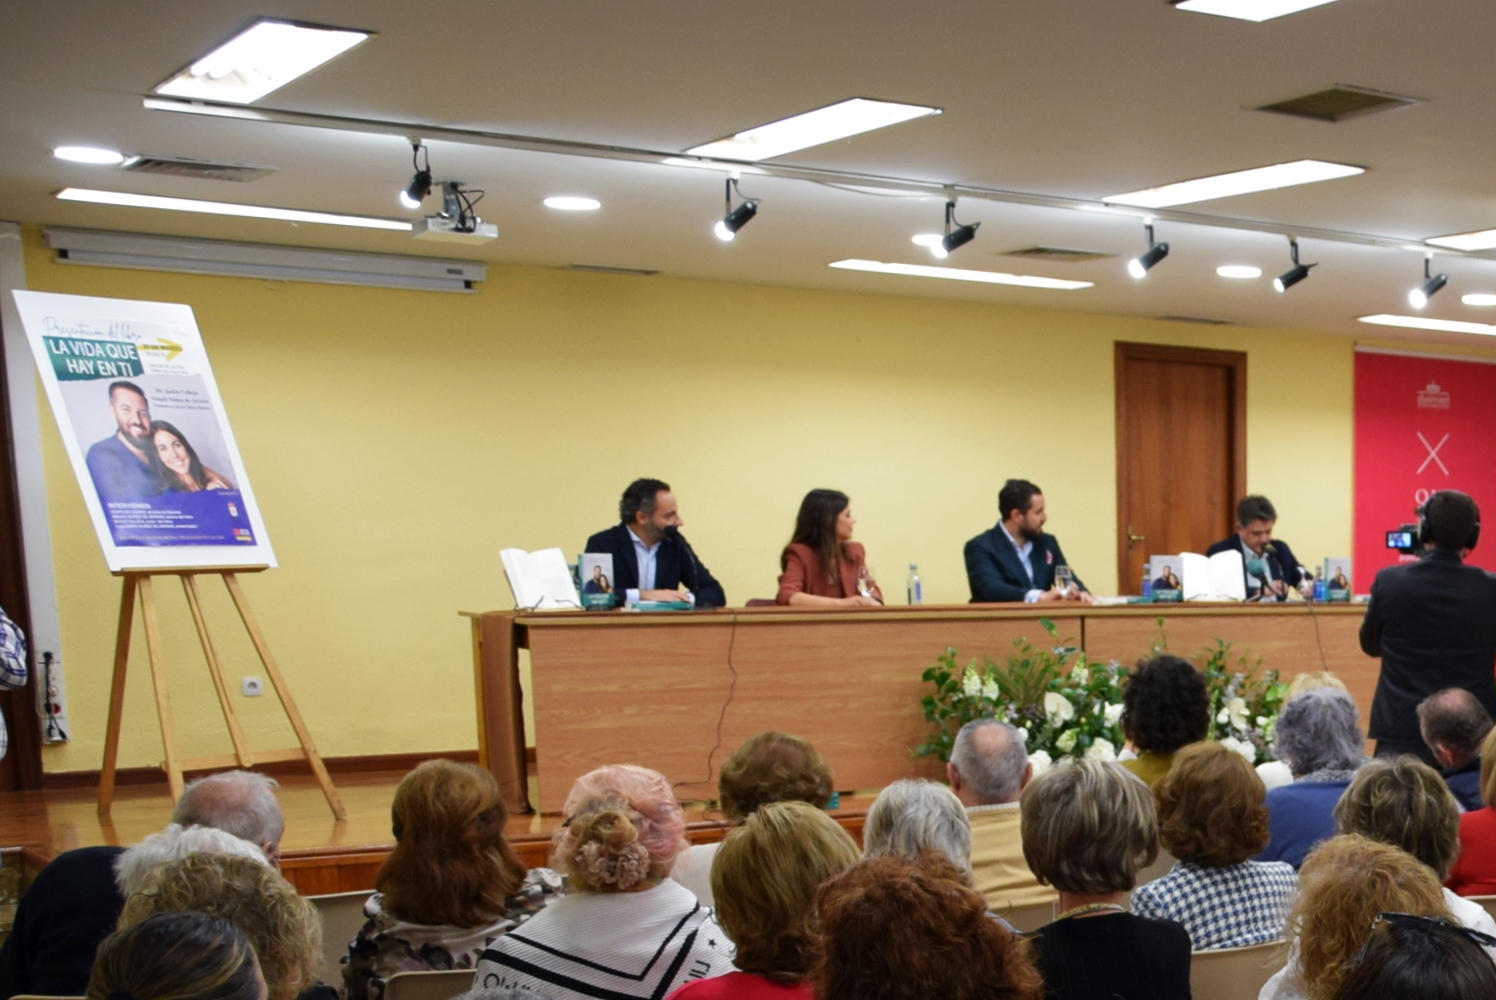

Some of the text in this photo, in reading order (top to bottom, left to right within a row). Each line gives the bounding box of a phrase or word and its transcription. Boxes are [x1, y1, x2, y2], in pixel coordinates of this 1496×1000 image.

[48, 340, 139, 361] LA VIDA QUE
[66, 358, 134, 377] HAY EN TI
